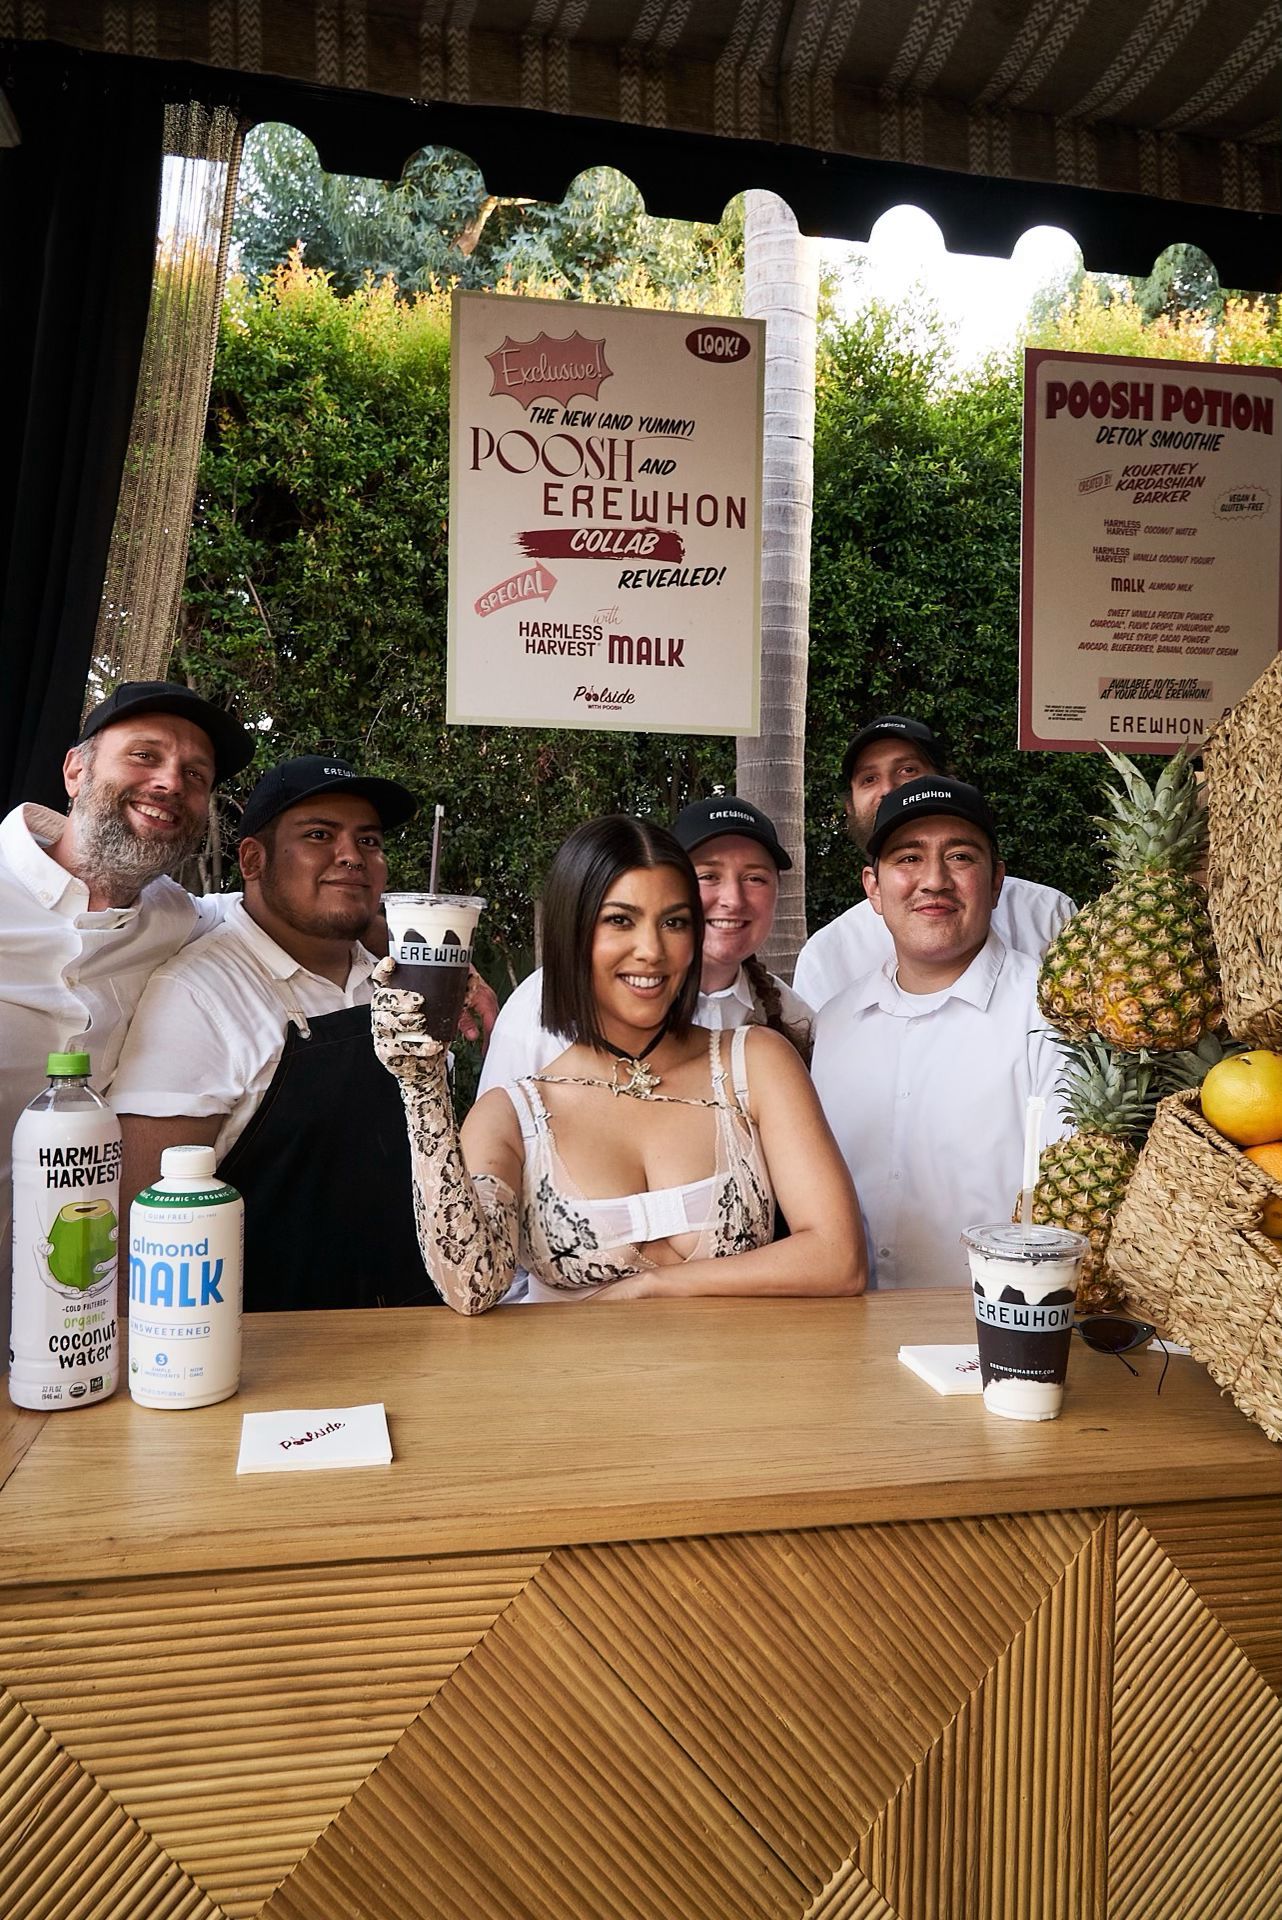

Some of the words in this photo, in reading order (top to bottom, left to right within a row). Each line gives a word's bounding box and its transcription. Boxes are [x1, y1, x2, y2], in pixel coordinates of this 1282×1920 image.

[698, 333, 740, 356] LOOK!
[500, 343, 602, 387] Exclusive!
[1046, 381, 1154, 420] POOSH
[1162, 385, 1274, 434] POTION
[530, 406, 558, 425] THE
[561, 409, 598, 428] NEW
[598, 412, 633, 431] (AND
[639, 416, 695, 437] YUMMY)
[1096, 425, 1148, 447] DETOX
[1150, 429, 1225, 451] SMOOTHIE
[469, 427, 635, 483] POOSH
[638, 458, 677, 476] AND
[1121, 462, 1199, 477] KOURTNEY
[1078, 475, 1104, 493] CREATED
[1102, 474, 1113, 486] BY
[1115, 476, 1206, 492] KARDASHIAN
[544, 482, 747, 529] EREWHON
[1133, 489, 1191, 504] BARKER
[1229, 494, 1249, 503] VEGAN
[1220, 502, 1265, 513] GLUTEN-FREE
[1103, 518, 1141, 529] HARMLESS
[1106, 527, 1138, 537] HARVEST
[1143, 525, 1174, 536] COCONUT
[1175, 527, 1198, 537] WATER
[570, 528, 660, 555] COLLAB
[1093, 546, 1130, 556] HARMLESS
[1095, 554, 1127, 563] HARVEST
[1133, 553, 1157, 562] VANILLA
[1159, 554, 1189, 564] COCONUT
[1190, 556, 1216, 566] YOGURT
[618, 566, 727, 589] REVEALED!
[1111, 577, 1145, 593] MALK
[1148, 581, 1176, 591] ALMOND
[1177, 583, 1195, 592] MILK
[479, 570, 550, 614] SPECIAL
[593, 605, 624, 625] with
[1107, 608, 1131, 617] SWEET
[1131, 609, 1156, 618] VANILLA
[519, 621, 604, 640] HARMLESS
[1112, 632, 1135, 641] MAPLE
[525, 638, 596, 657] HARVEST
[608, 634, 686, 667] MALK
[1109, 678, 1152, 690] AVAILABLE
[1152, 678, 1198, 690] 10/15-11/15
[573, 686, 636, 704] Poolside
[1100, 689, 1112, 700] AT
[1114, 689, 1138, 700] YOUR
[1138, 689, 1163, 700] LOCAL
[1165, 688, 1211, 700] EREWHON!
[1110, 715, 1204, 735] EREWHON
[902, 790, 952, 806] EREWHON
[709, 810, 755, 823] EREWHON
[46, 1161, 120, 1188] HARVEST
[154, 1195, 189, 1203] ORGANIC
[133, 1236, 208, 1257] almond
[64, 1312, 105, 1331] organic
[979, 1302, 1069, 1326] EREWHON
[49, 1319, 117, 1353] coconut
[59, 1343, 112, 1369] water
[158, 1355, 166, 1364] 3
[989, 1362, 1055, 1375] EREWHONMARKET.COM
